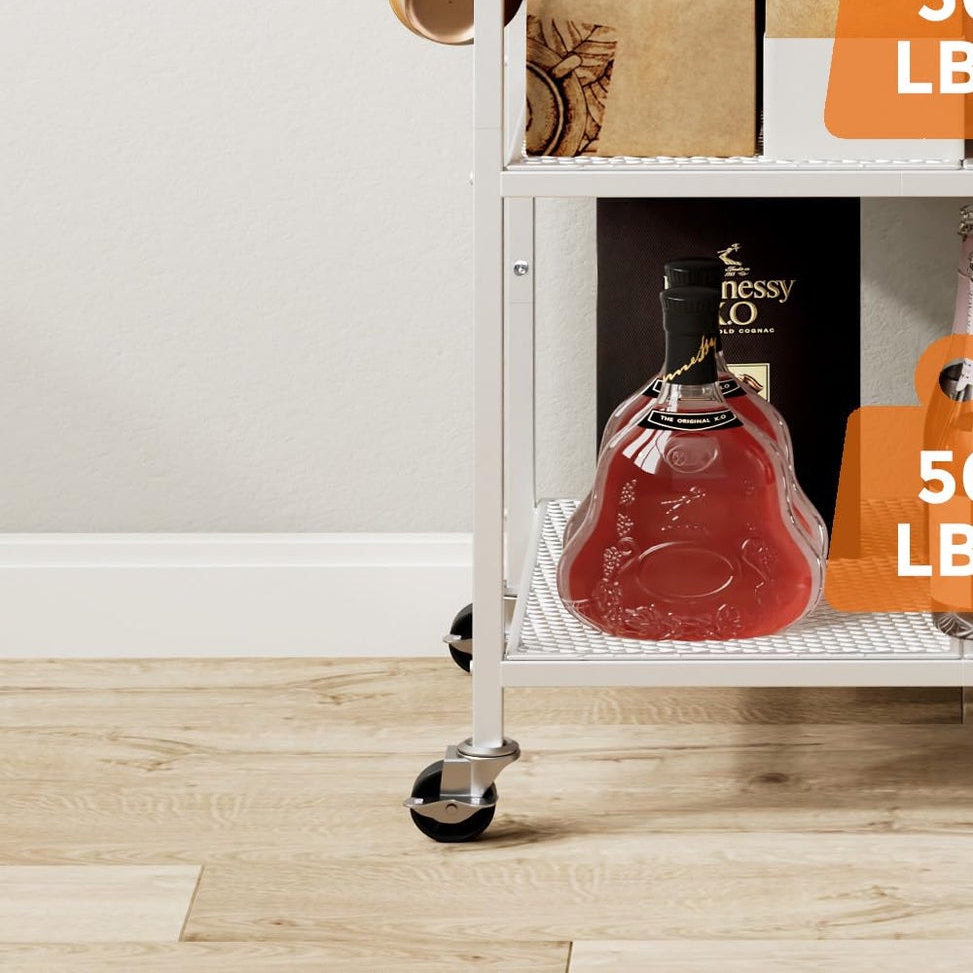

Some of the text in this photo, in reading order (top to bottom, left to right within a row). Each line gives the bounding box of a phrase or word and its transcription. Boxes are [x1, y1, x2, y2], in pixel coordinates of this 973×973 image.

[720, 279, 796, 304] nessy
[660, 414, 674, 423] THE
[677, 417, 711, 425] ORIGINAL
